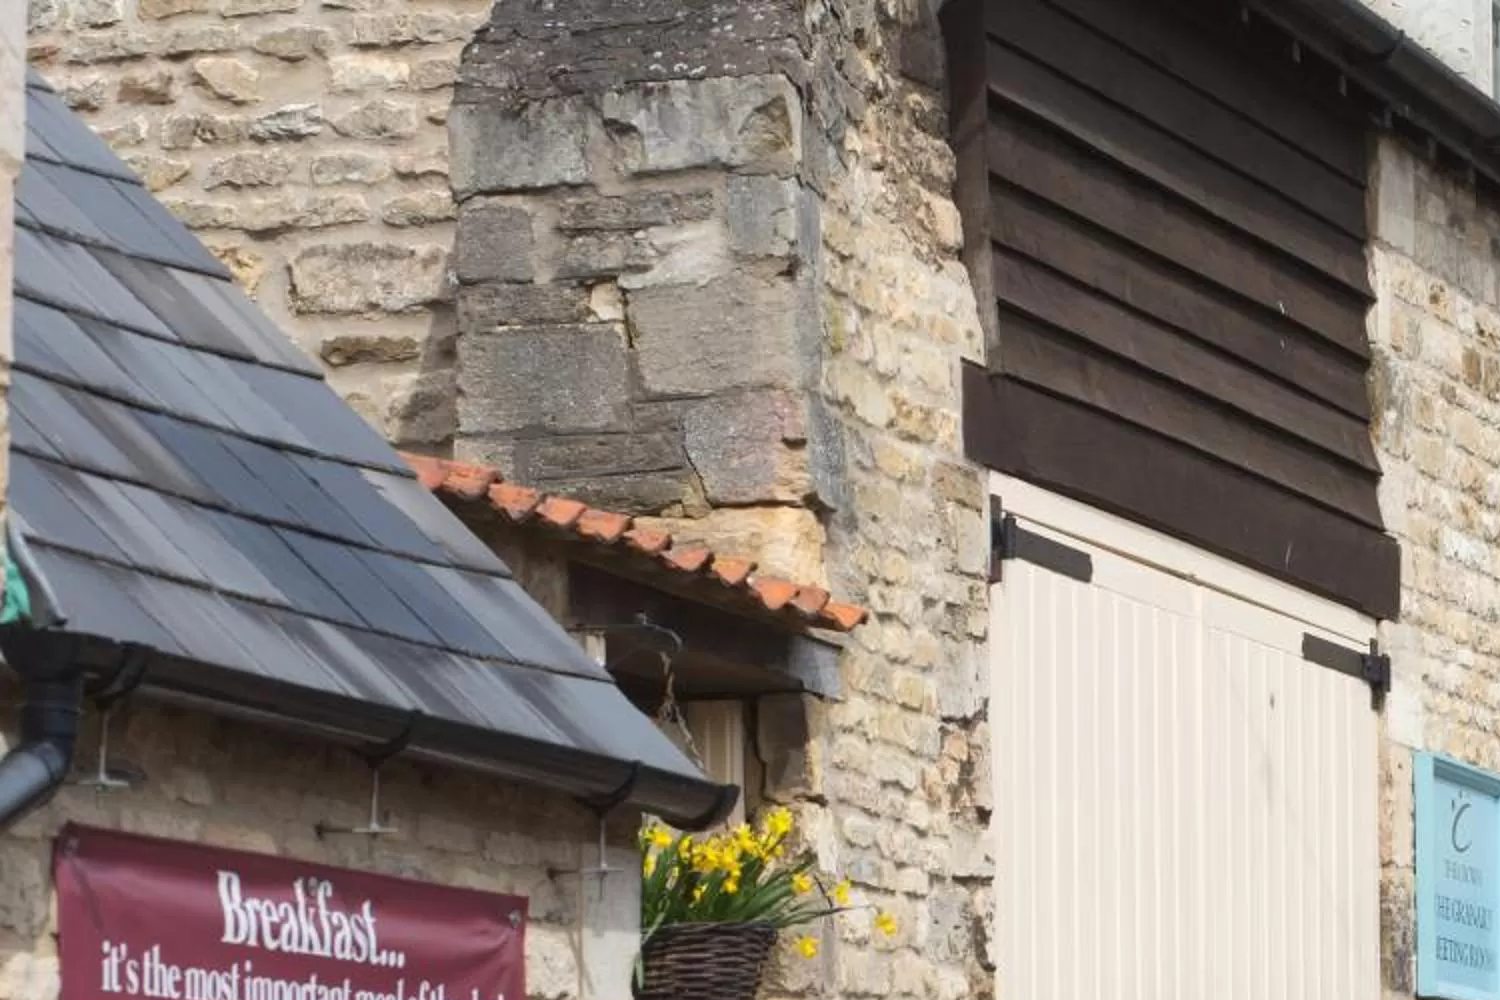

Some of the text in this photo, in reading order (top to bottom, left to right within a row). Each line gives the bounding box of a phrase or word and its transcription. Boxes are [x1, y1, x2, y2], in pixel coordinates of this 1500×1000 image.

[217, 870, 405, 968] Breakfast...
[101, 940, 140, 995] it's
[143, 944, 181, 1000] the
